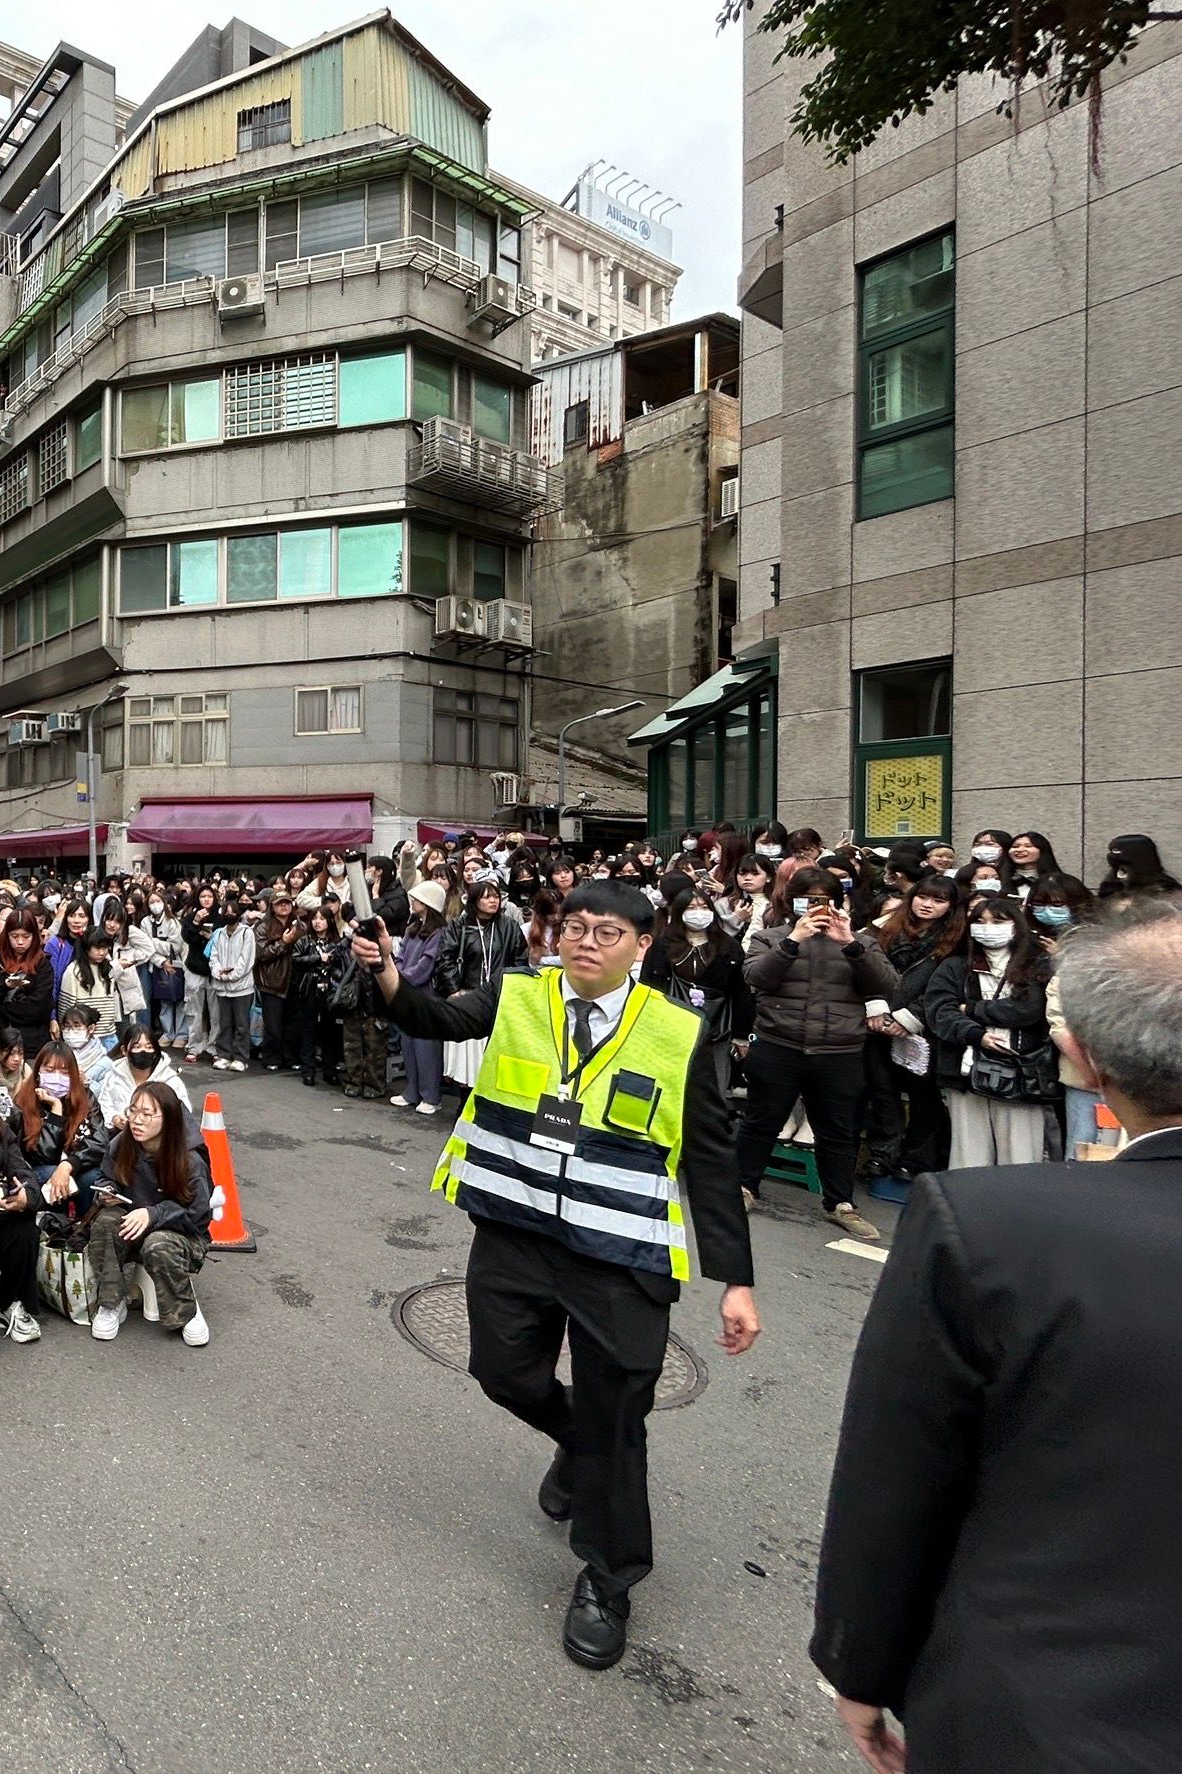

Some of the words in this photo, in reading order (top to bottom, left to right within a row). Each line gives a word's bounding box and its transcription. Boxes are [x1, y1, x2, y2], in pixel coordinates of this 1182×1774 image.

[606, 204, 638, 231] Allianz
[876, 791, 937, 811] ドット
[544, 1113, 571, 1126] PRADA
